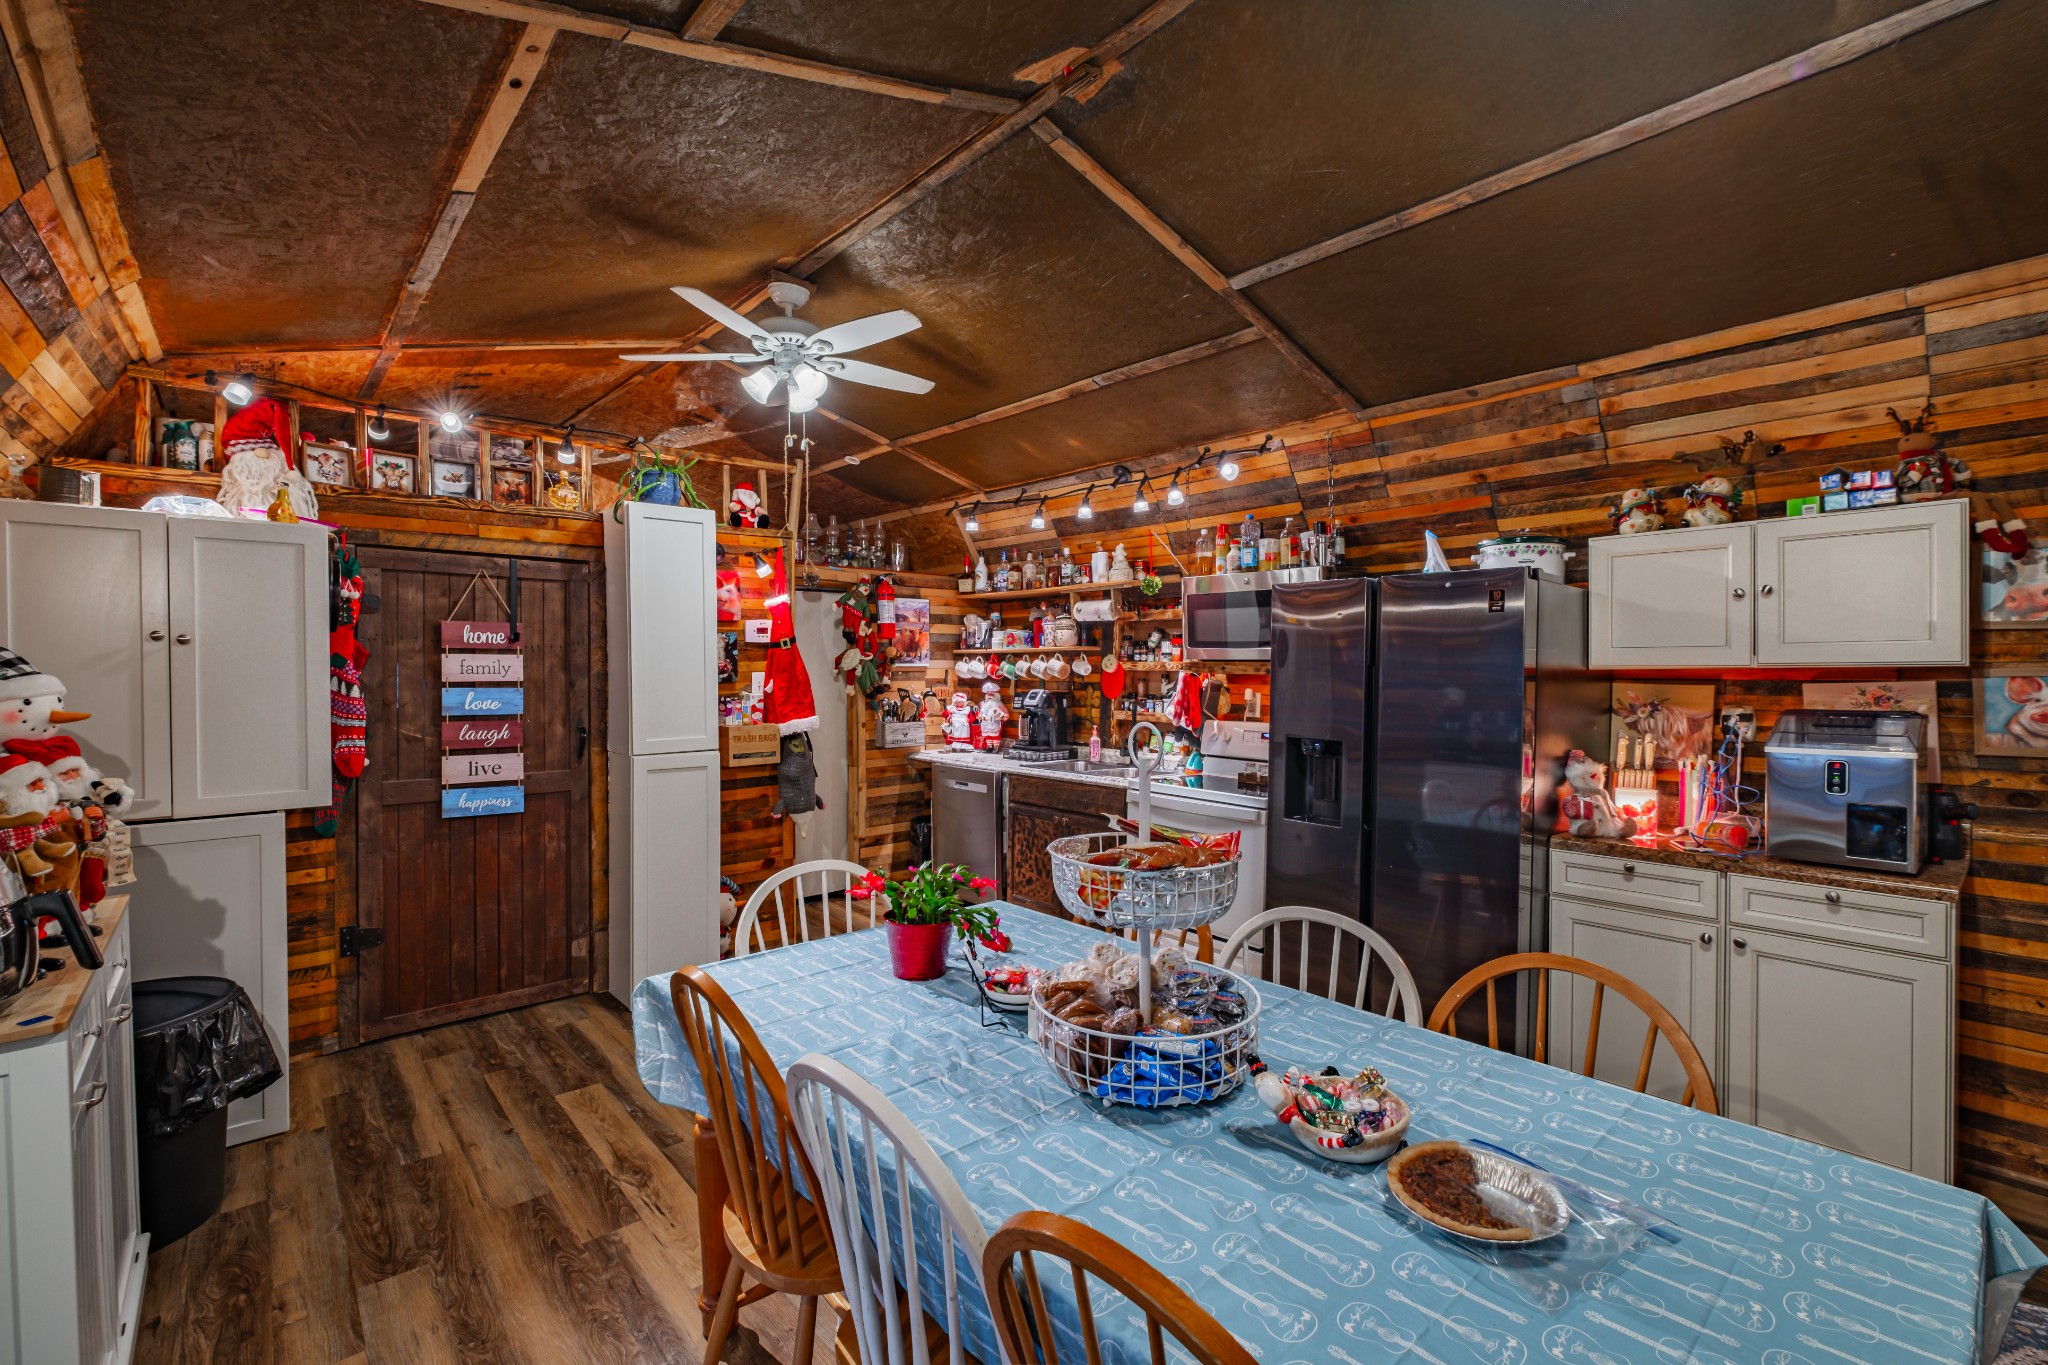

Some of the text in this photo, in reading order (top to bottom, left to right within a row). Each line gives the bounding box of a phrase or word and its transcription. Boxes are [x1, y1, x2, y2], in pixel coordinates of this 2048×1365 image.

[463, 624, 507, 644] home
[459, 659, 512, 678] family
[464, 691, 502, 710] love
[459, 723, 510, 747] laugh
[732, 733, 778, 744] TRASH BAGS
[468, 761, 502, 777] live
[458, 792, 513, 813] happiness
